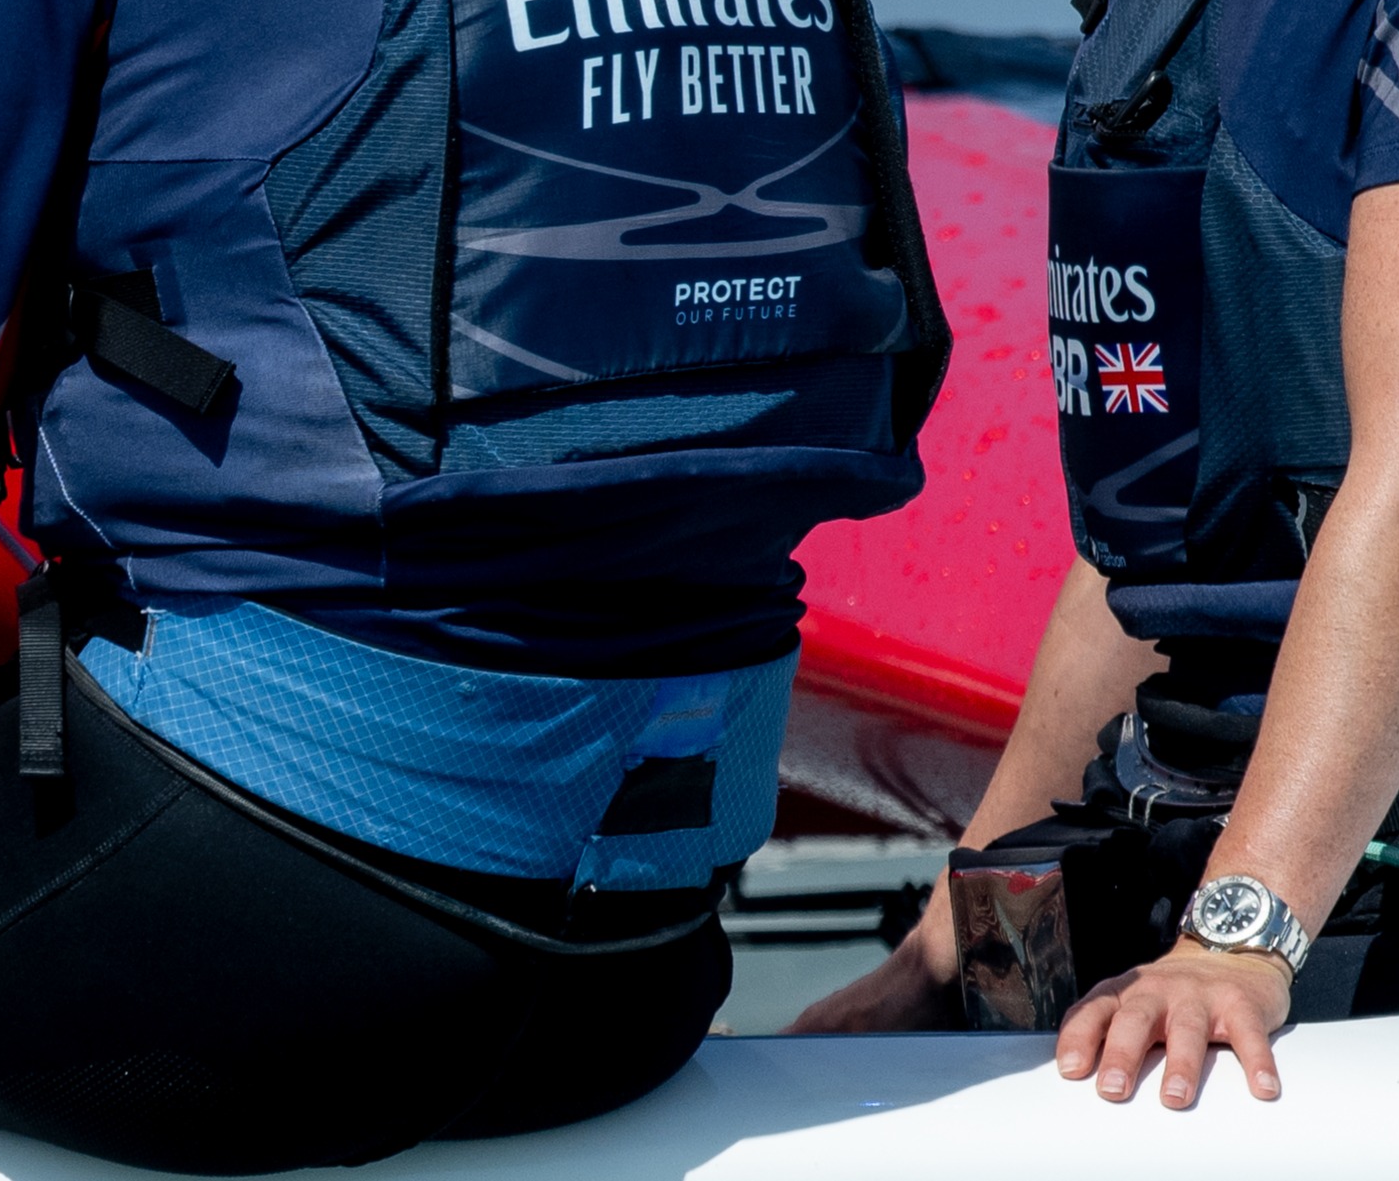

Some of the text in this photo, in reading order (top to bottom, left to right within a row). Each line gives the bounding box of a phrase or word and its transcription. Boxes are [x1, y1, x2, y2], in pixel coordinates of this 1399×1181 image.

[582, 45, 816, 130] FLY BETTER
[674, 275, 802, 307] PROTECT
[675, 303, 798, 325] OUR FUTURE
[1051, 334, 1092, 417] BR
